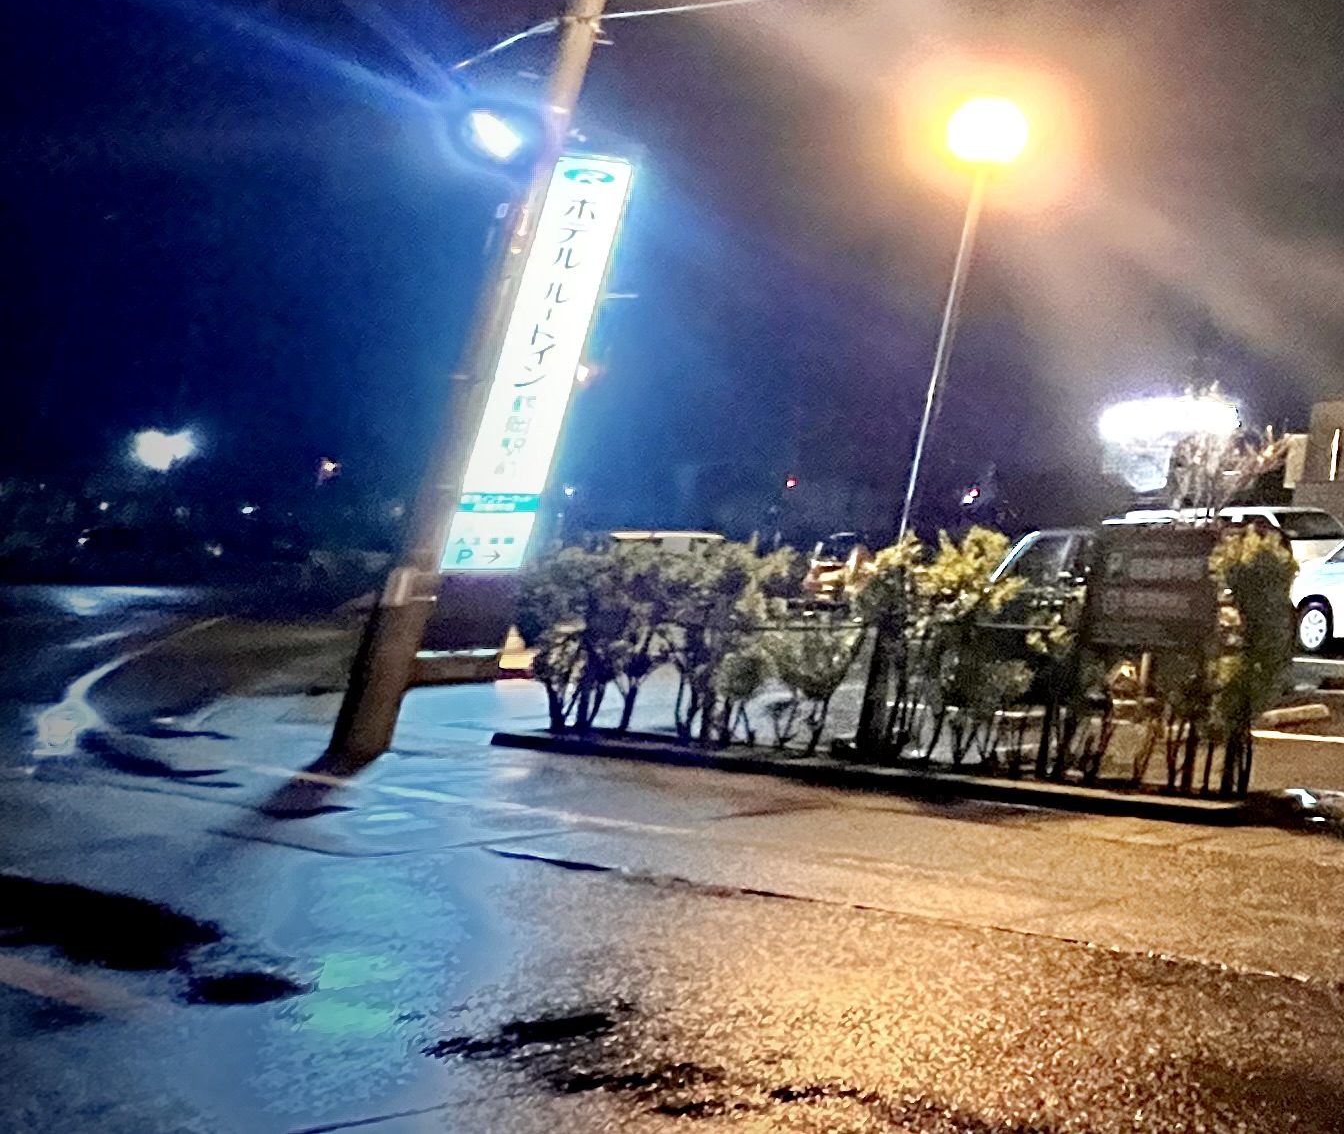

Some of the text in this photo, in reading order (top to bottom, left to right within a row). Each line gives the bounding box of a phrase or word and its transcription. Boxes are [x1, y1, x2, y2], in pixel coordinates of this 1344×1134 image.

[552, 198, 597, 270] ホテル
[513, 282, 571, 389] ルートイン
[455, 549, 474, 564] P
